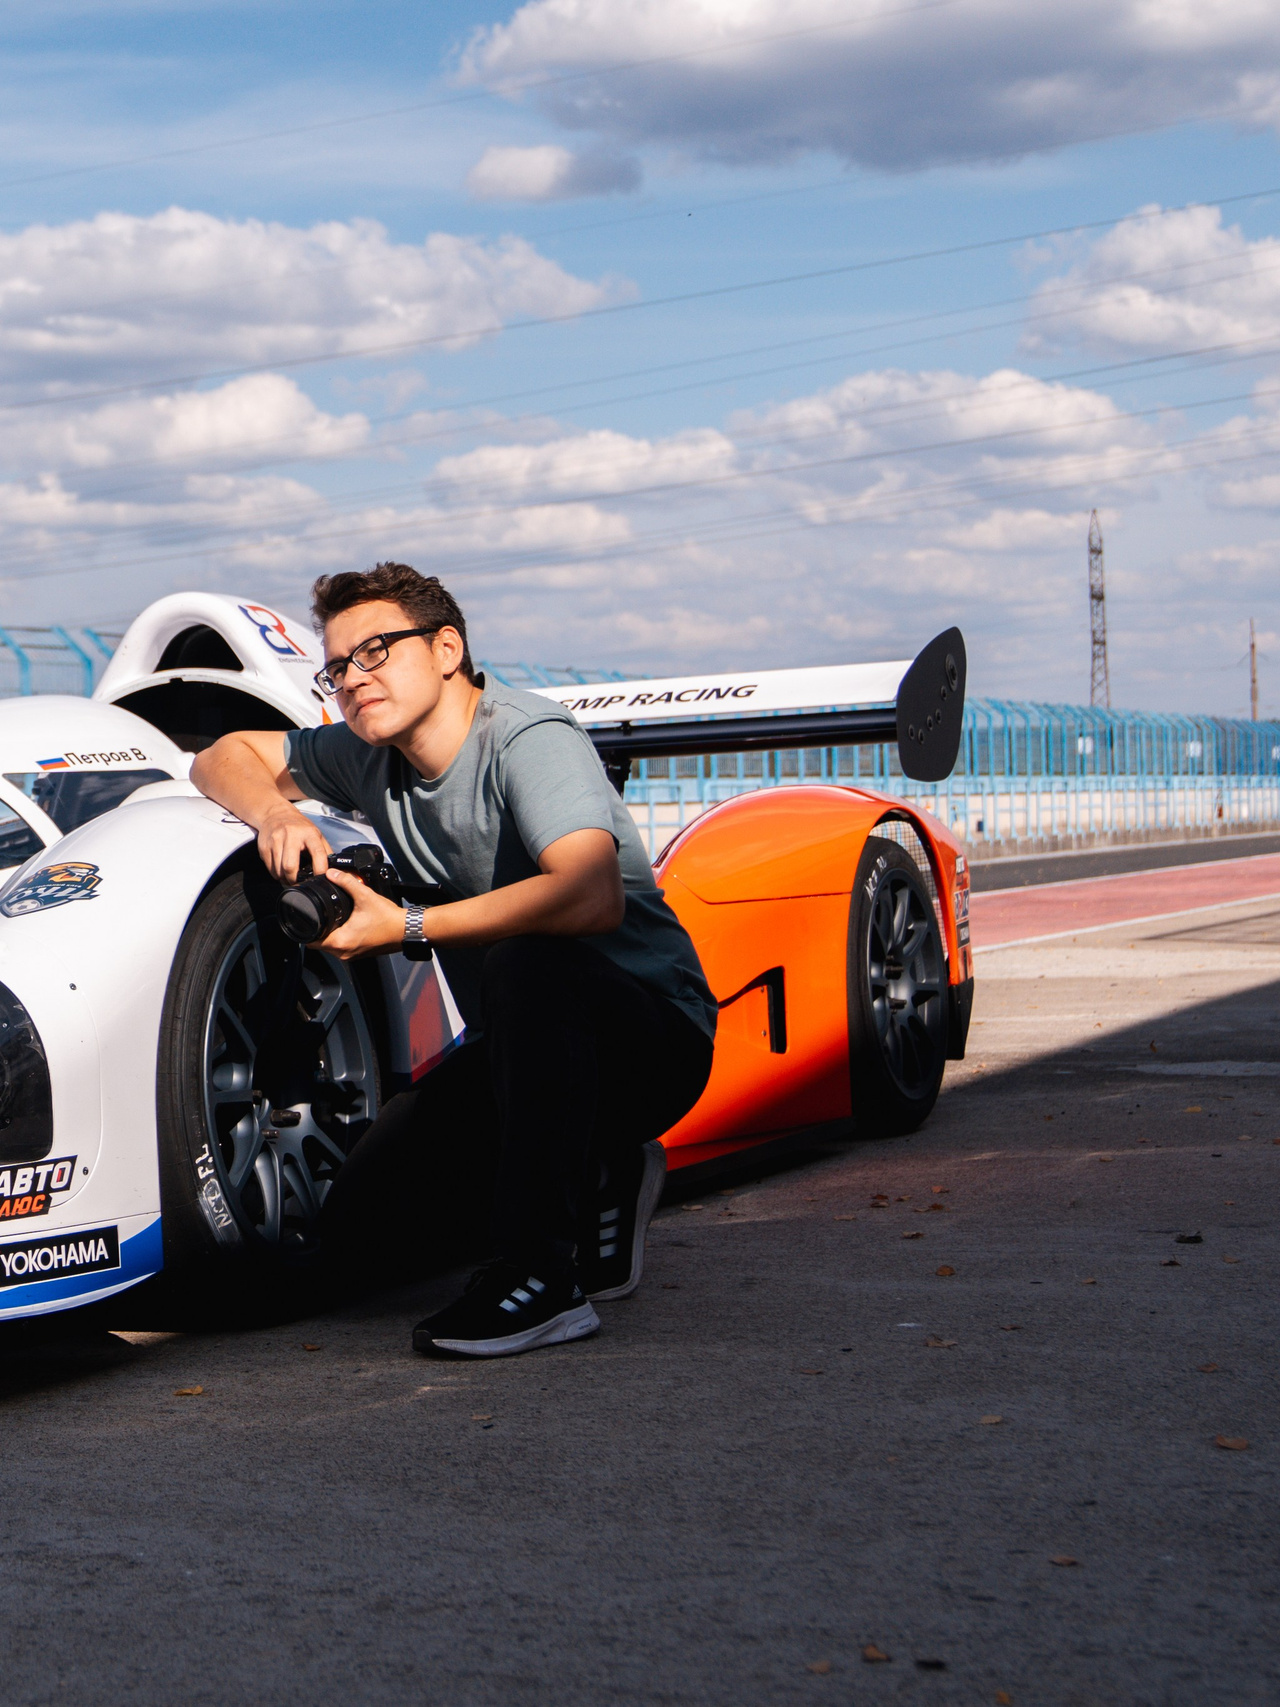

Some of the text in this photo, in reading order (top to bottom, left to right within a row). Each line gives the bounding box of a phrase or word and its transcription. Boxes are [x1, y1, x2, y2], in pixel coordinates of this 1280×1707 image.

[627, 684, 758, 707] RACING
[64, 751, 132, 767] Петров
[0, 1237, 110, 1277] YOKOHAMA
